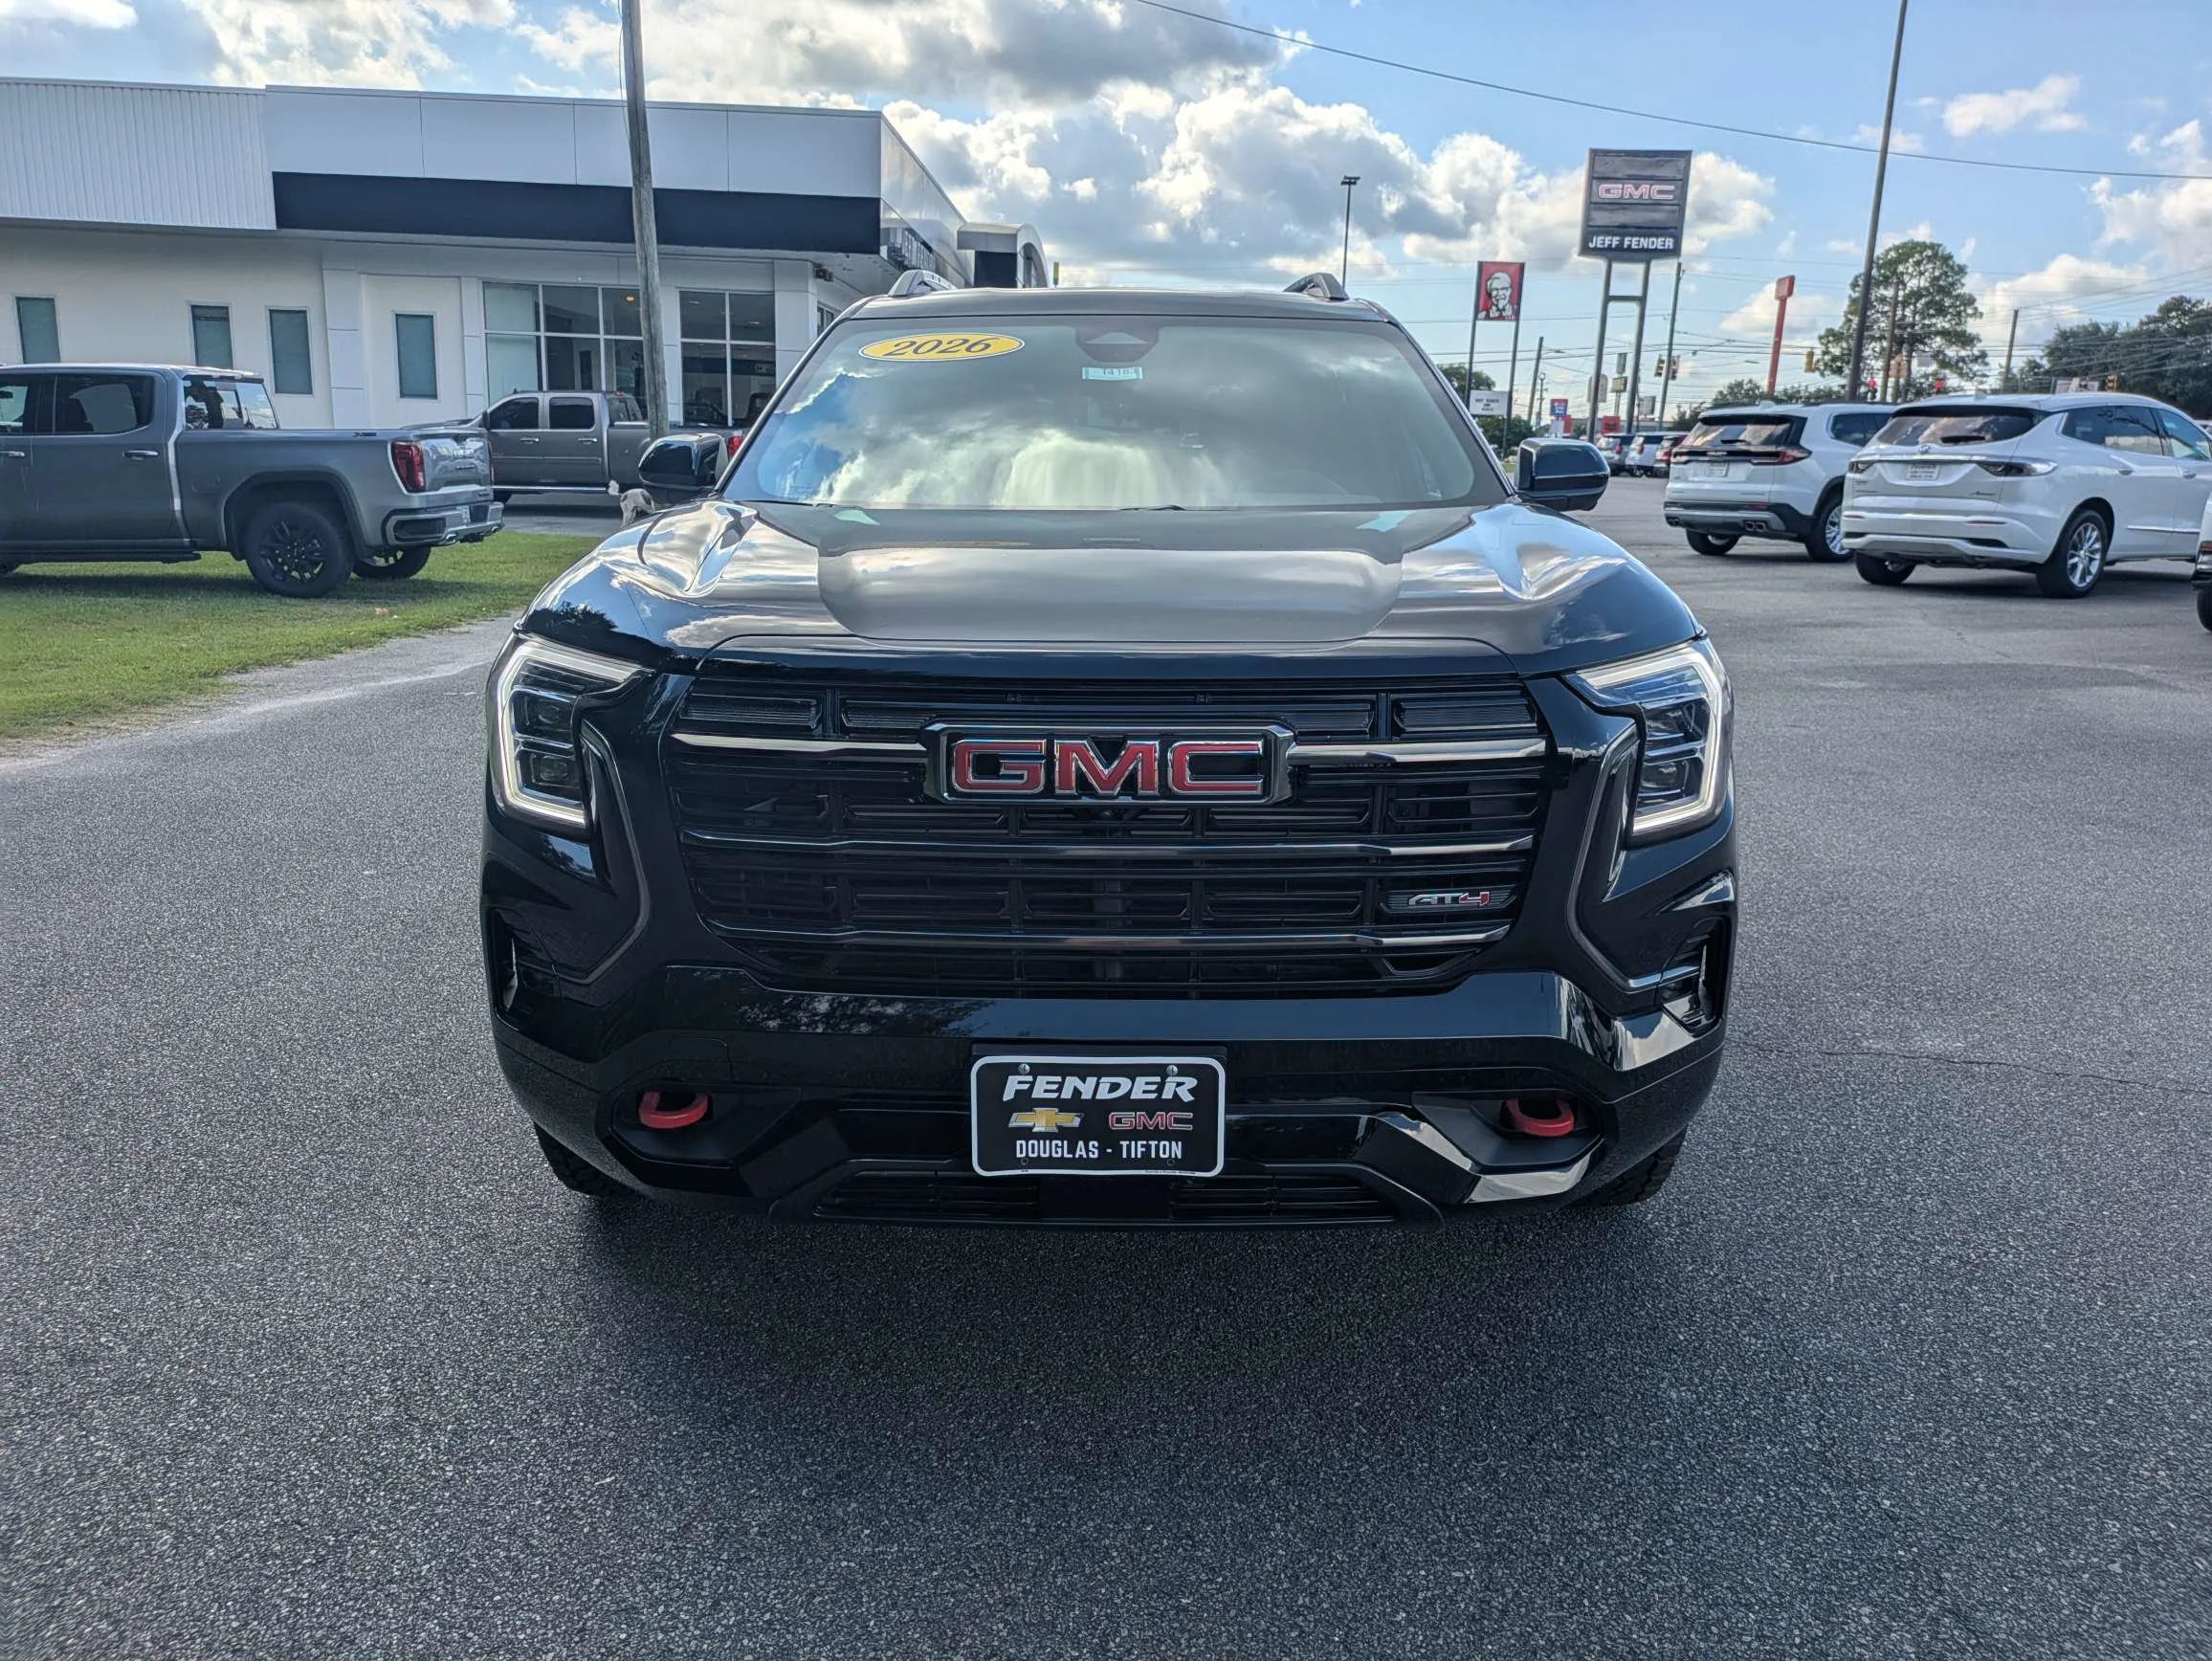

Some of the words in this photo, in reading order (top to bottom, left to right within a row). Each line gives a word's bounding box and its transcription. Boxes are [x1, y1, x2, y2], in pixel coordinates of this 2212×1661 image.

[1599, 183, 1675, 200] GMC
[1588, 235, 1621, 249] JEFF
[1624, 236, 1674, 250] FENDER
[882, 337, 1001, 357] 2026
[952, 738, 1265, 796] GMC
[1408, 891, 1491, 907] AT4
[1003, 1074, 1198, 1102] FENDER
[1108, 1112, 1194, 1130] GMC
[1016, 1140, 1099, 1159] DOUGLAS
[1119, 1141, 1183, 1159] TIFTON
